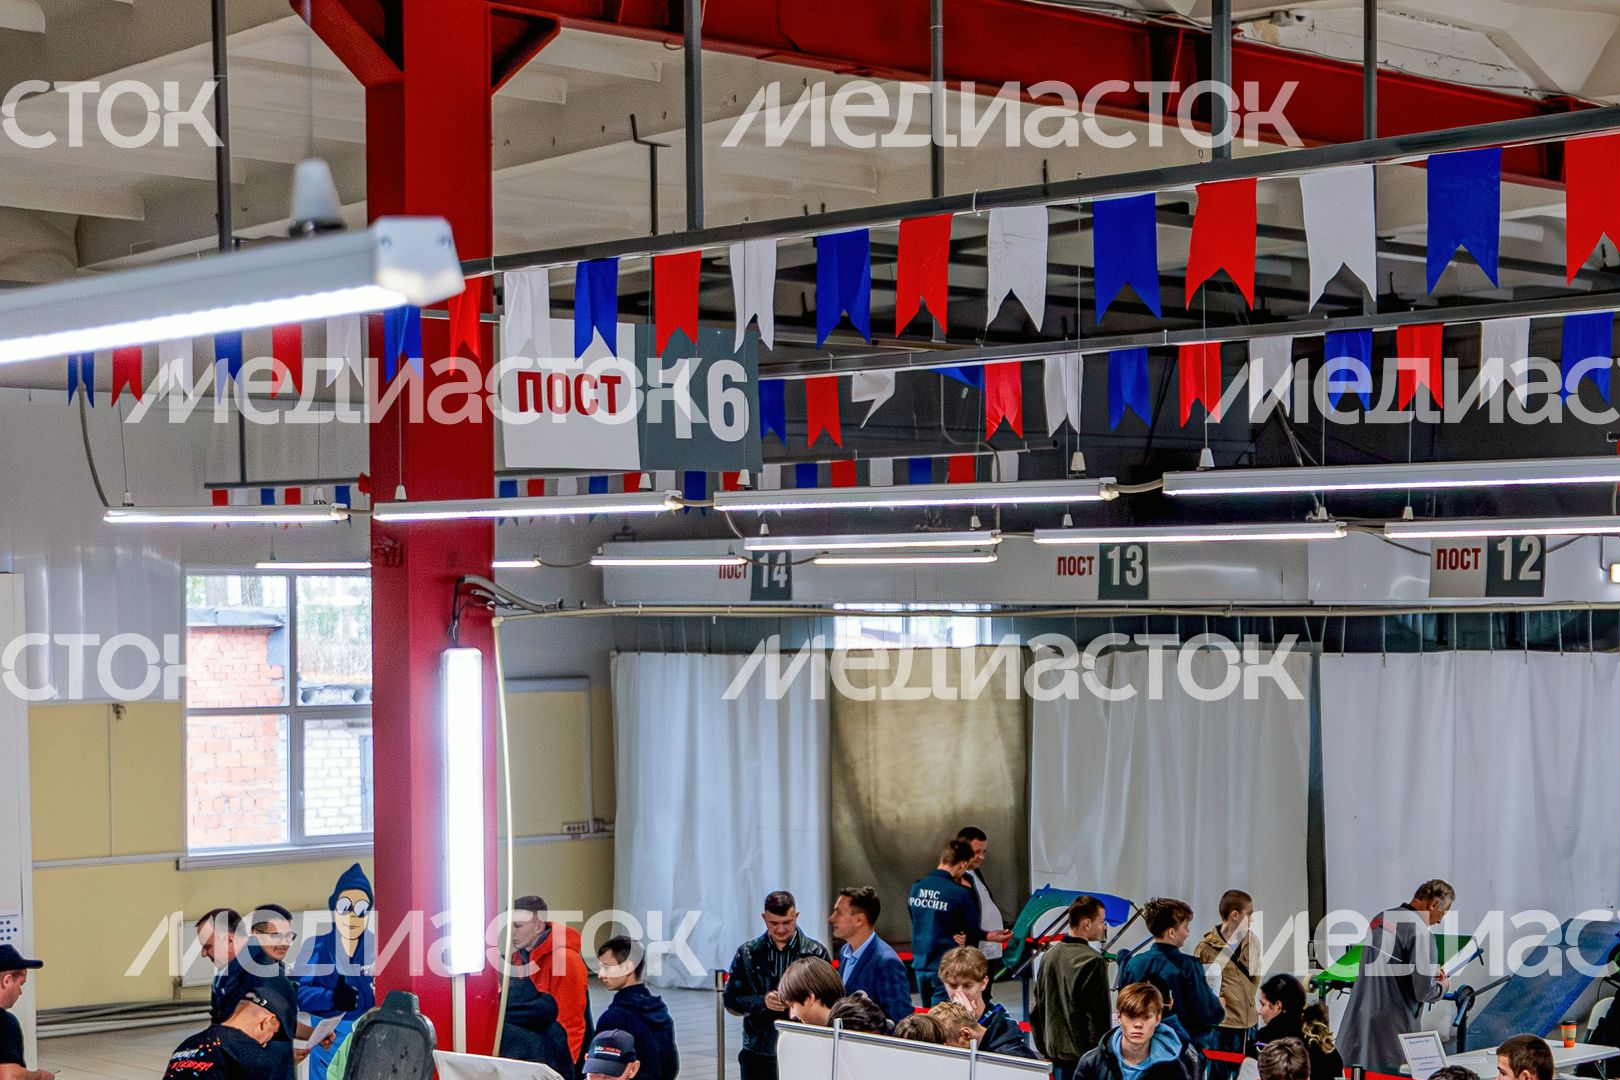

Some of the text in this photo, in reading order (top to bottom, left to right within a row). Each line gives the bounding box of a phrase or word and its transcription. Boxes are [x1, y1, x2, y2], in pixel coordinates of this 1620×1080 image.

[517, 359, 749, 442] ПОСТ 16
[758, 552, 788, 588] 14
[1057, 544, 1143, 586] ПОСТ 13
[1436, 535, 1541, 580] ПОСТ 12
[909, 897, 948, 910] РОССИИ
[919, 888, 940, 899] МЧС
